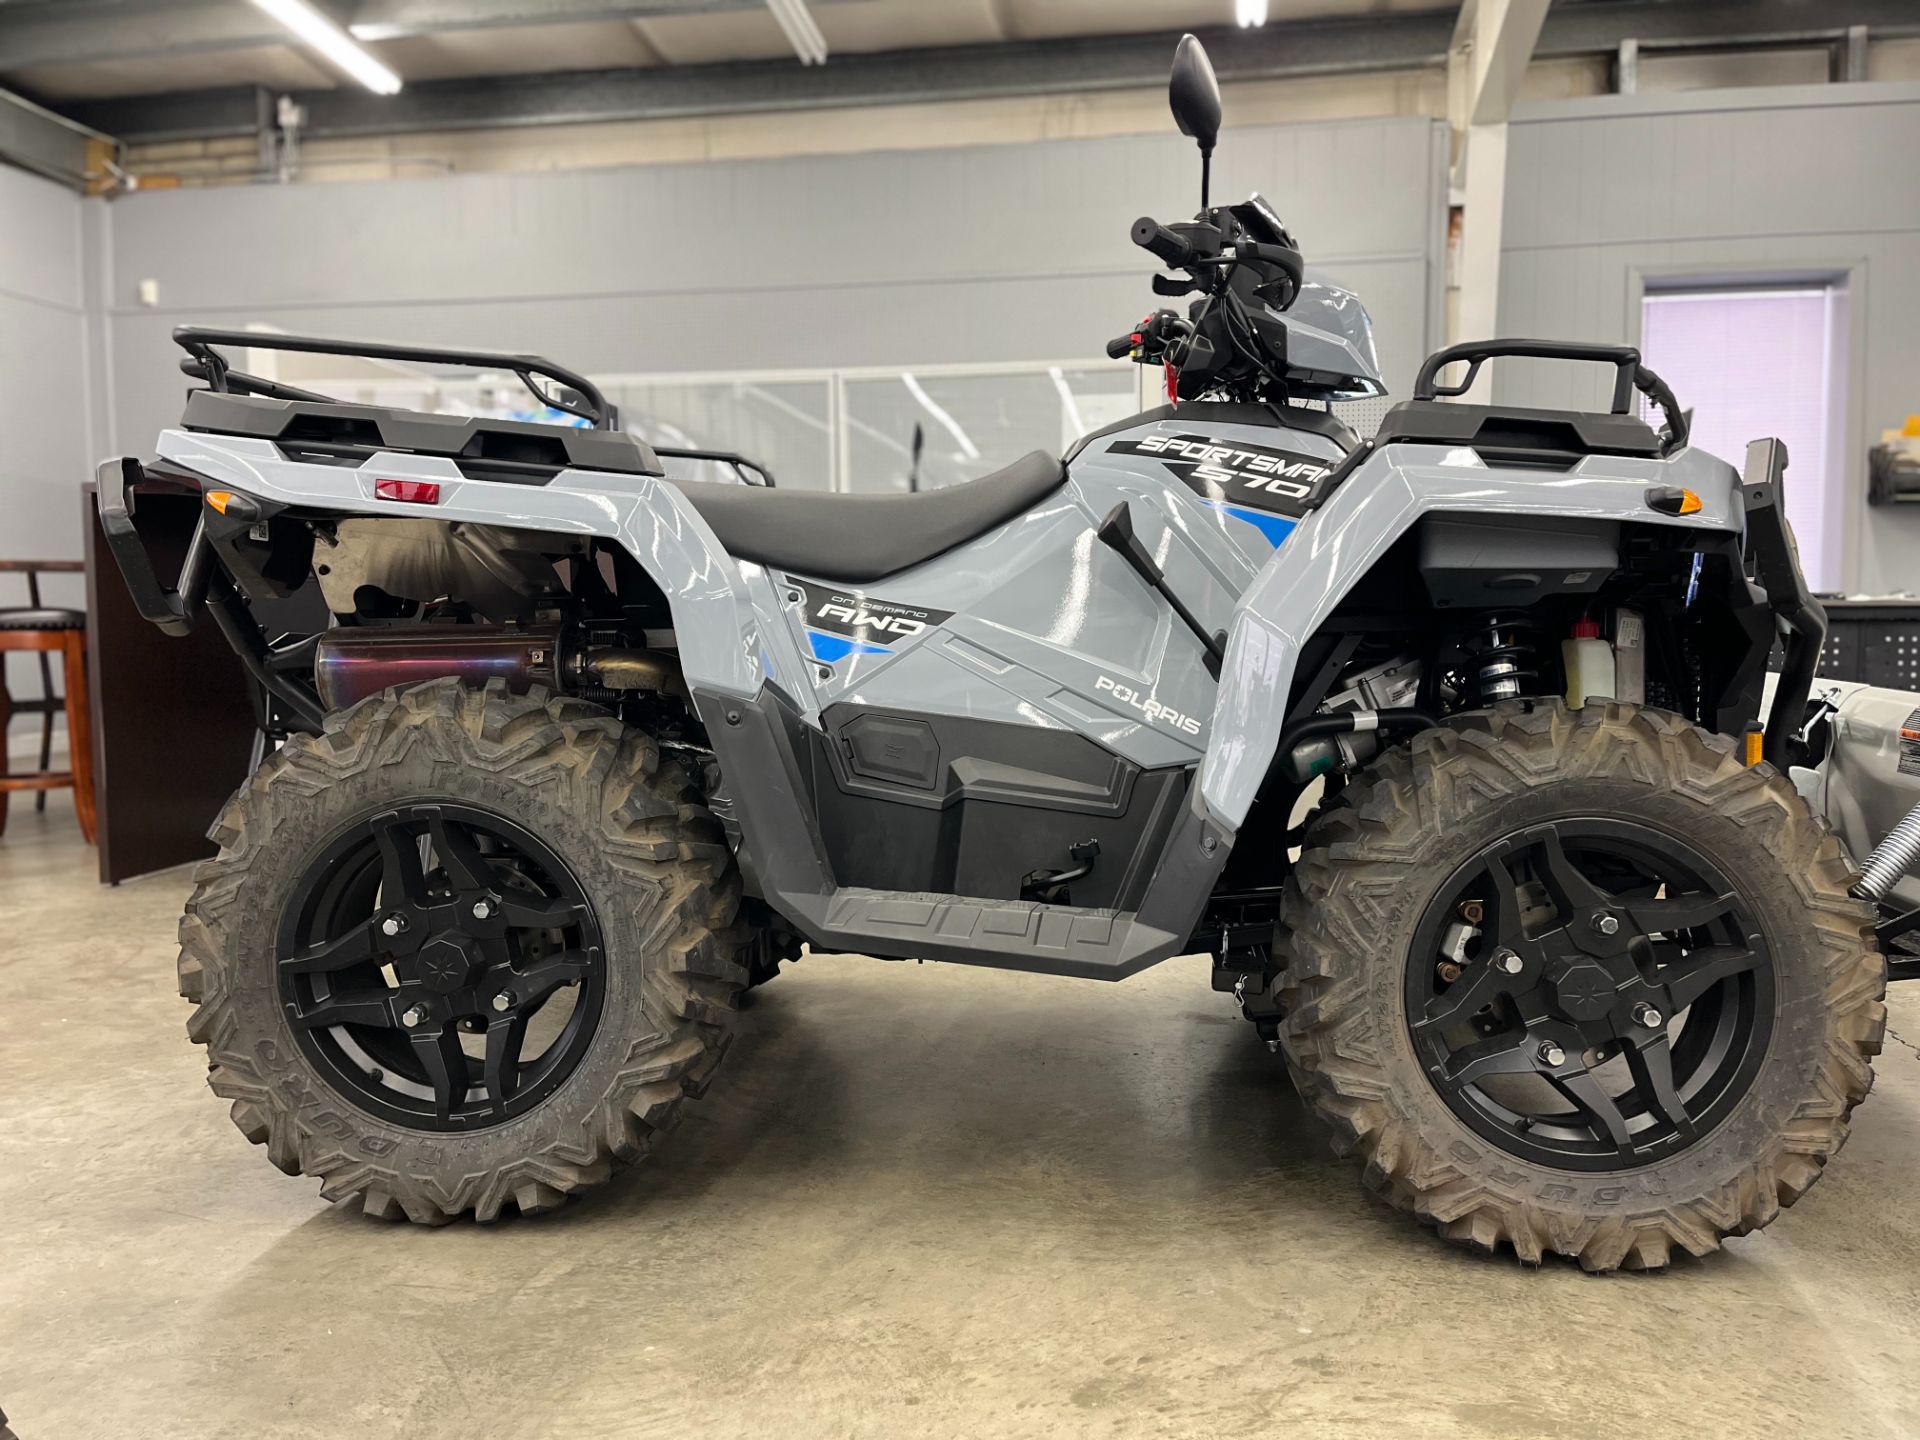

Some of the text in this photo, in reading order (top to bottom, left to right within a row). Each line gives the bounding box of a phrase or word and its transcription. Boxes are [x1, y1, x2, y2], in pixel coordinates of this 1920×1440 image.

[1190, 465, 1311, 498] 570
[816, 603, 927, 635] AWD
[831, 595, 928, 618] ON DEMAND
[1095, 675, 1202, 735] POLARIS
